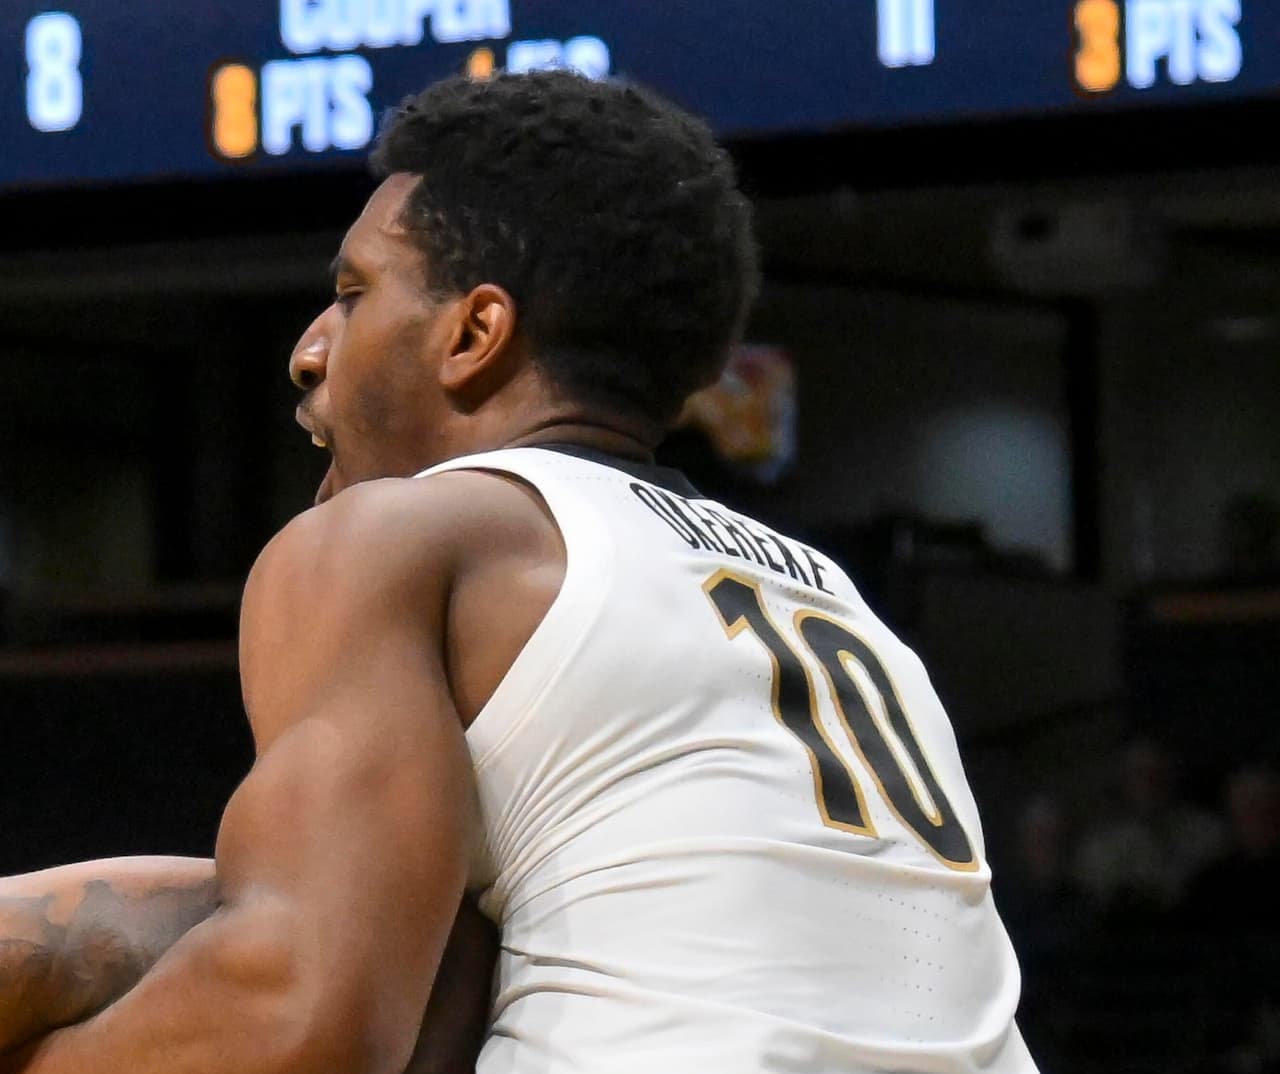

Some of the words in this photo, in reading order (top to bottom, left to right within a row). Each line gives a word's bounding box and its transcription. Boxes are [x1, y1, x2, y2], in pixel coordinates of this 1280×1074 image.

[26, 12, 82, 132] 8
[1075, 0, 1119, 91] 3
[1126, 0, 1241, 88] PTS
[261, 54, 374, 155] PTS
[629, 482, 837, 596] OKEREKE
[701, 568, 980, 872] 10
